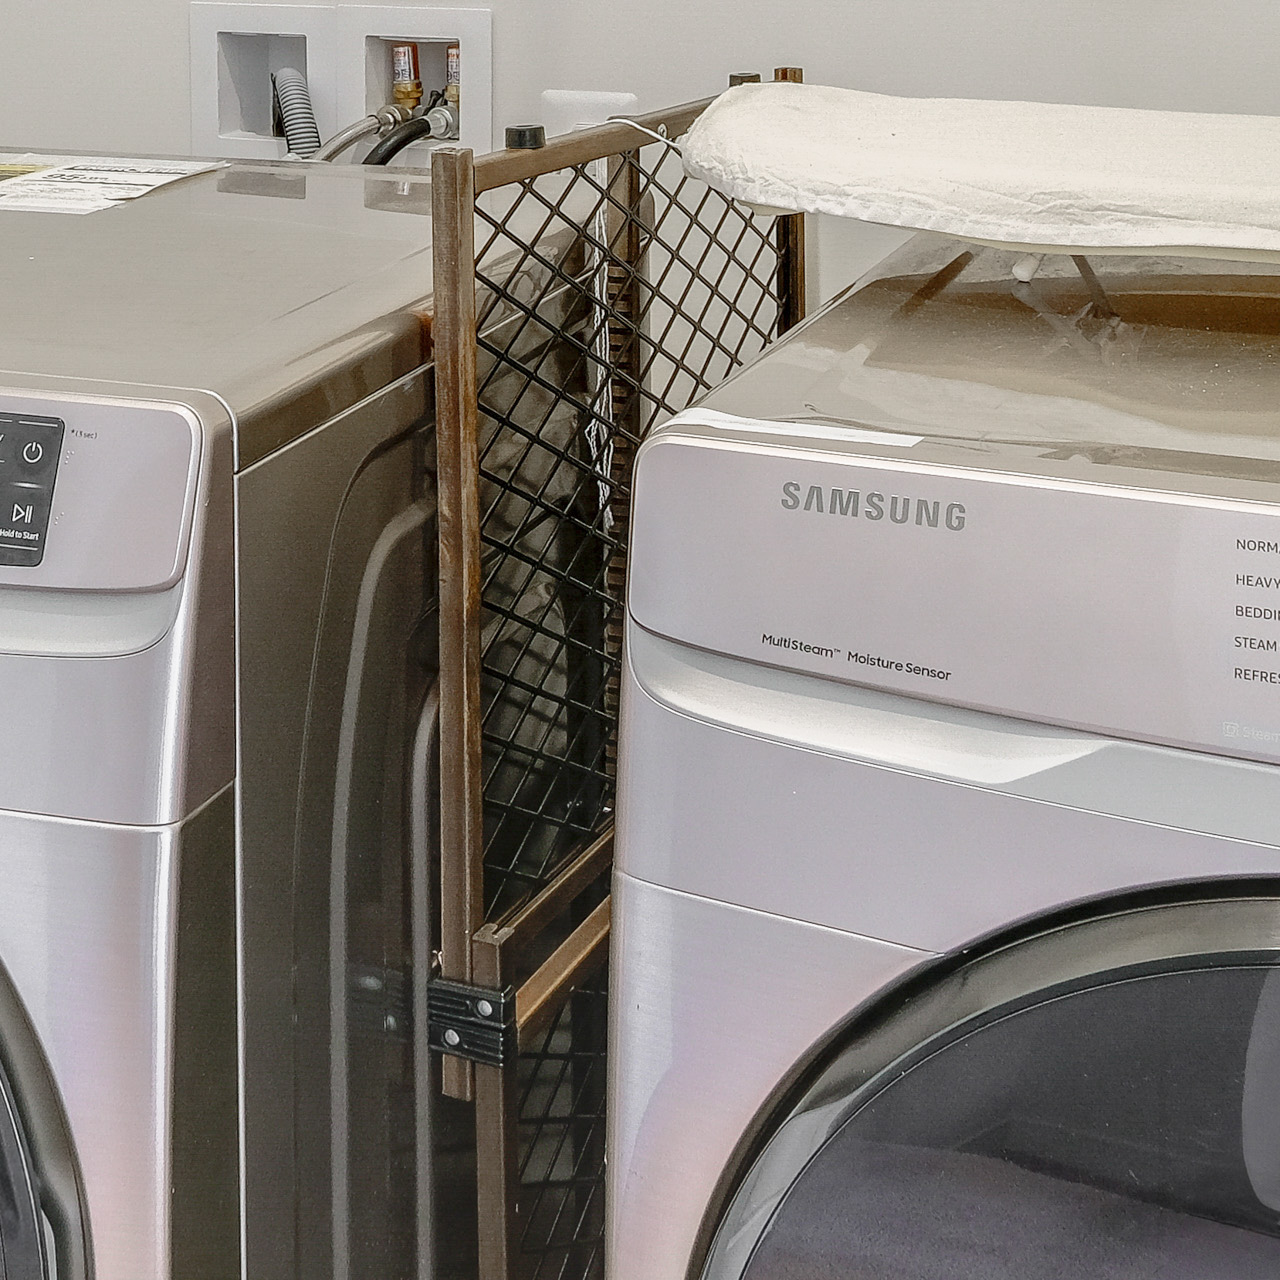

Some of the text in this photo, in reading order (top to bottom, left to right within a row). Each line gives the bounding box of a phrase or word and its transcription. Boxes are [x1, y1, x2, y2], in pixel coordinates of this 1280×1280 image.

[780, 480, 967, 532] SAMSUNG
[0, 529, 39, 541] Hold to Start
[1234, 636, 1278, 654] STEAM
[847, 650, 904, 673] Moisture
[905, 660, 952, 682] Sensor
